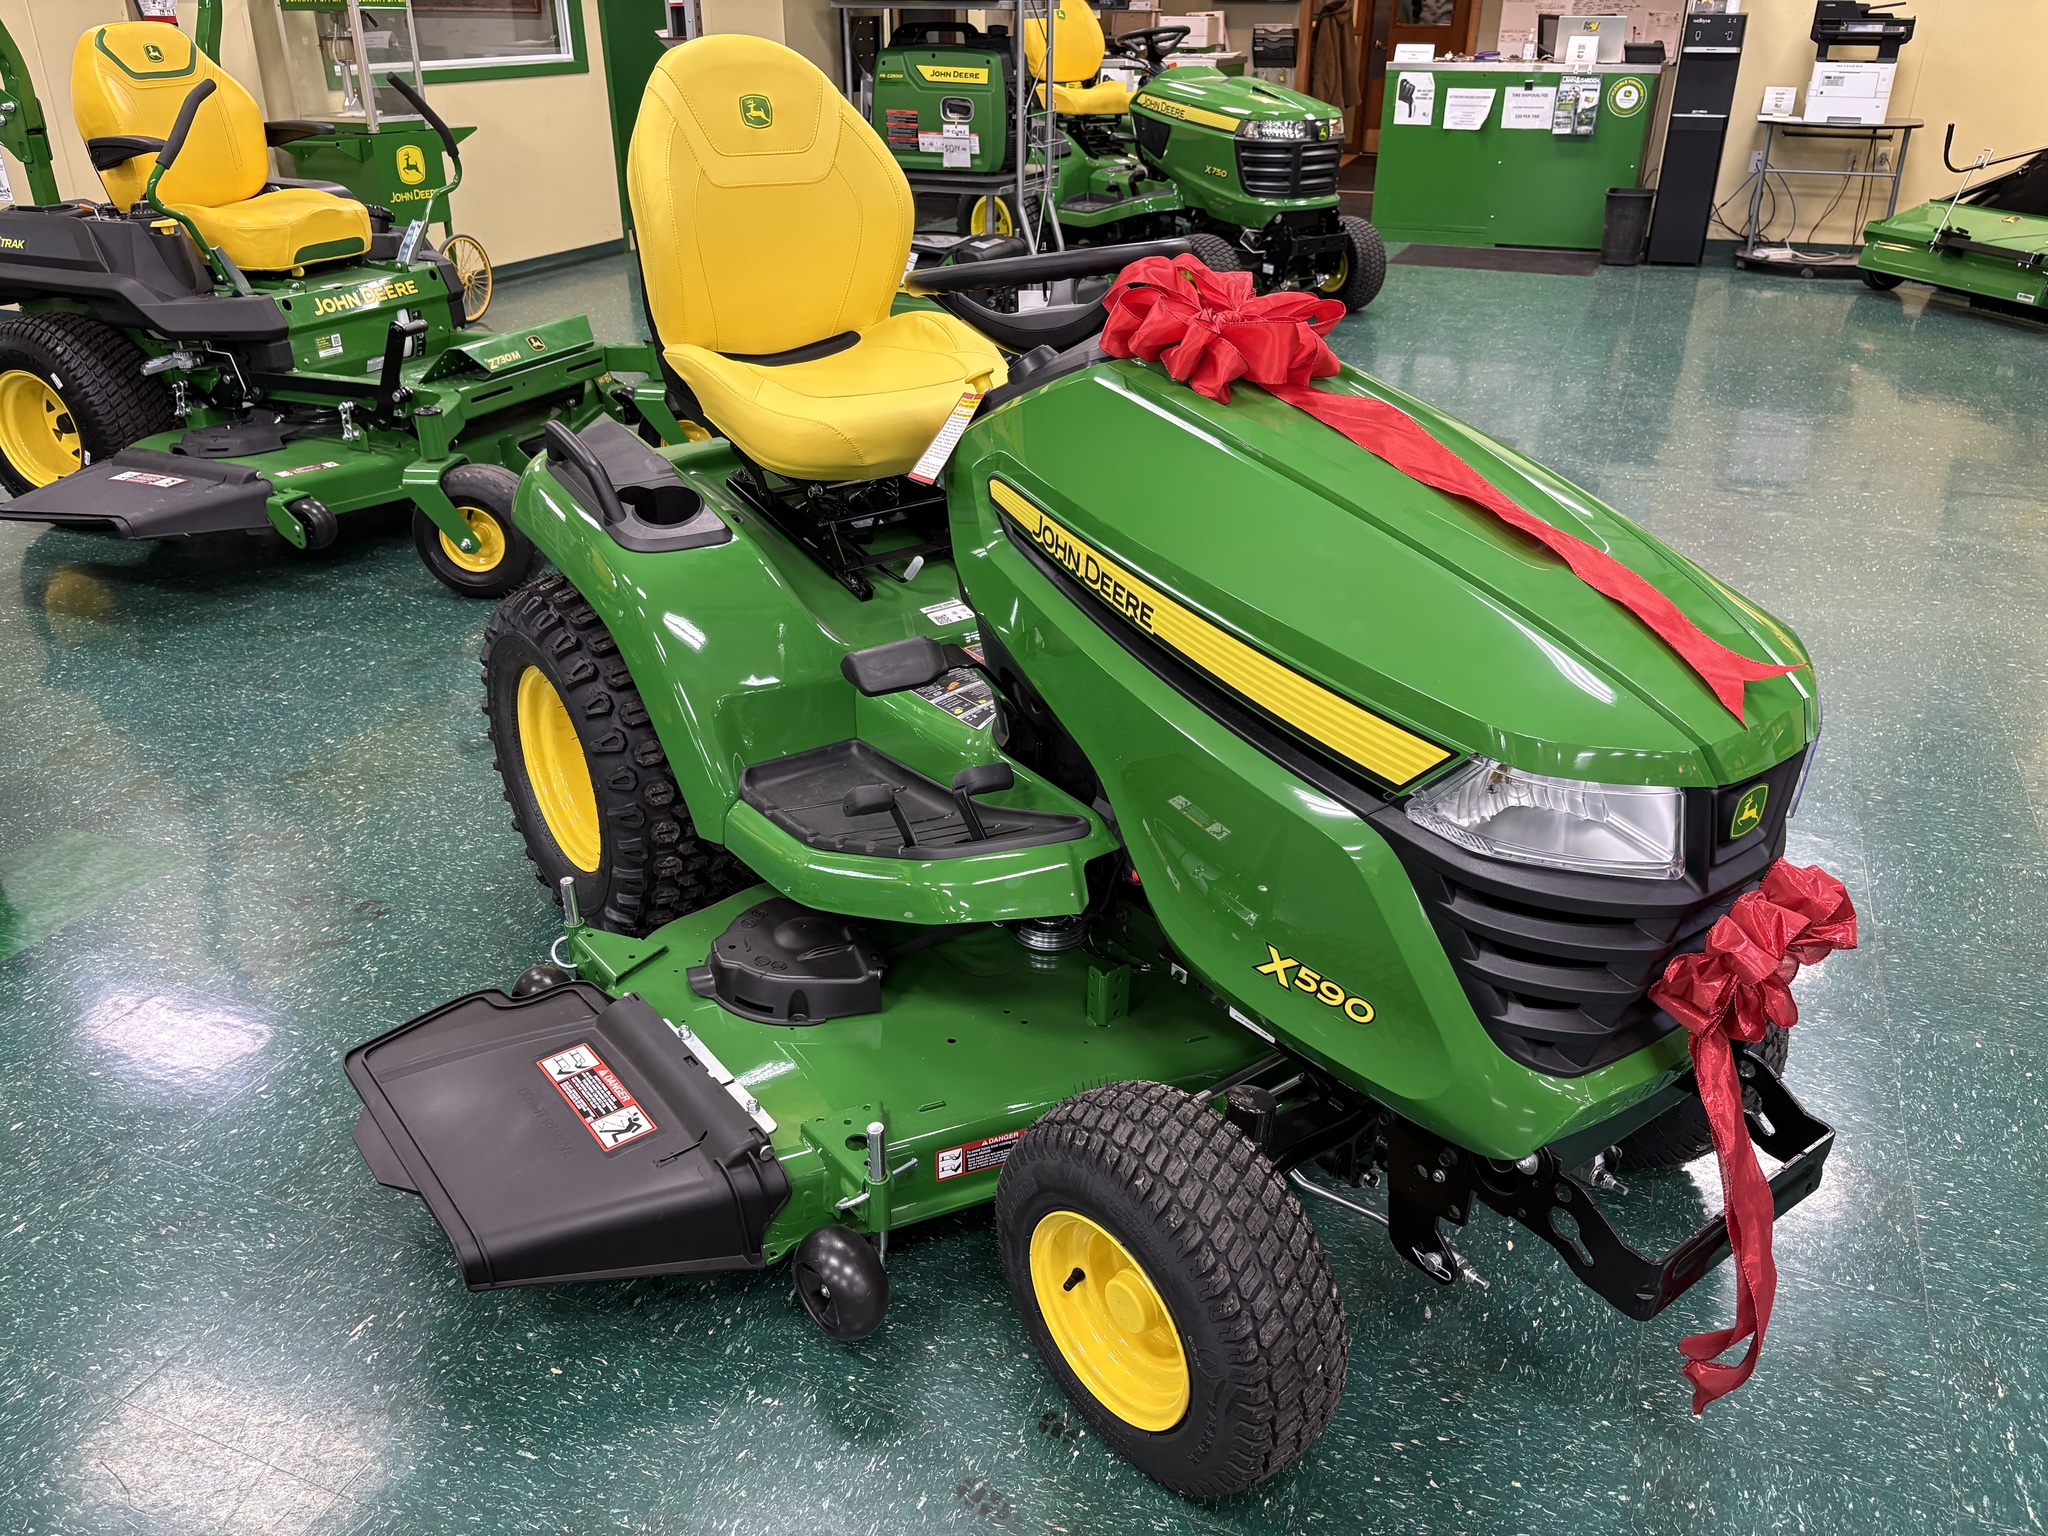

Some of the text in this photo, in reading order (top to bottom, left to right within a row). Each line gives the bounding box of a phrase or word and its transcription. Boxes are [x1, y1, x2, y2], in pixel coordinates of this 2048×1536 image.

[930, 69, 980, 79] JOHN DEERE
[1611, 79, 1645, 97] FLEXIBLE FINANCING
[1141, 96, 1186, 119] JOHN DEERE
[1204, 164, 1228, 178] X750
[390, 191, 414, 203] JOHN
[314, 280, 419, 316] JOHN DEERE
[1032, 514, 1155, 631] JOHN DEERE
[1251, 940, 1377, 1025] X590
[603, 1074, 631, 1102] DANGER
[988, 1131, 1019, 1145] DANGER
